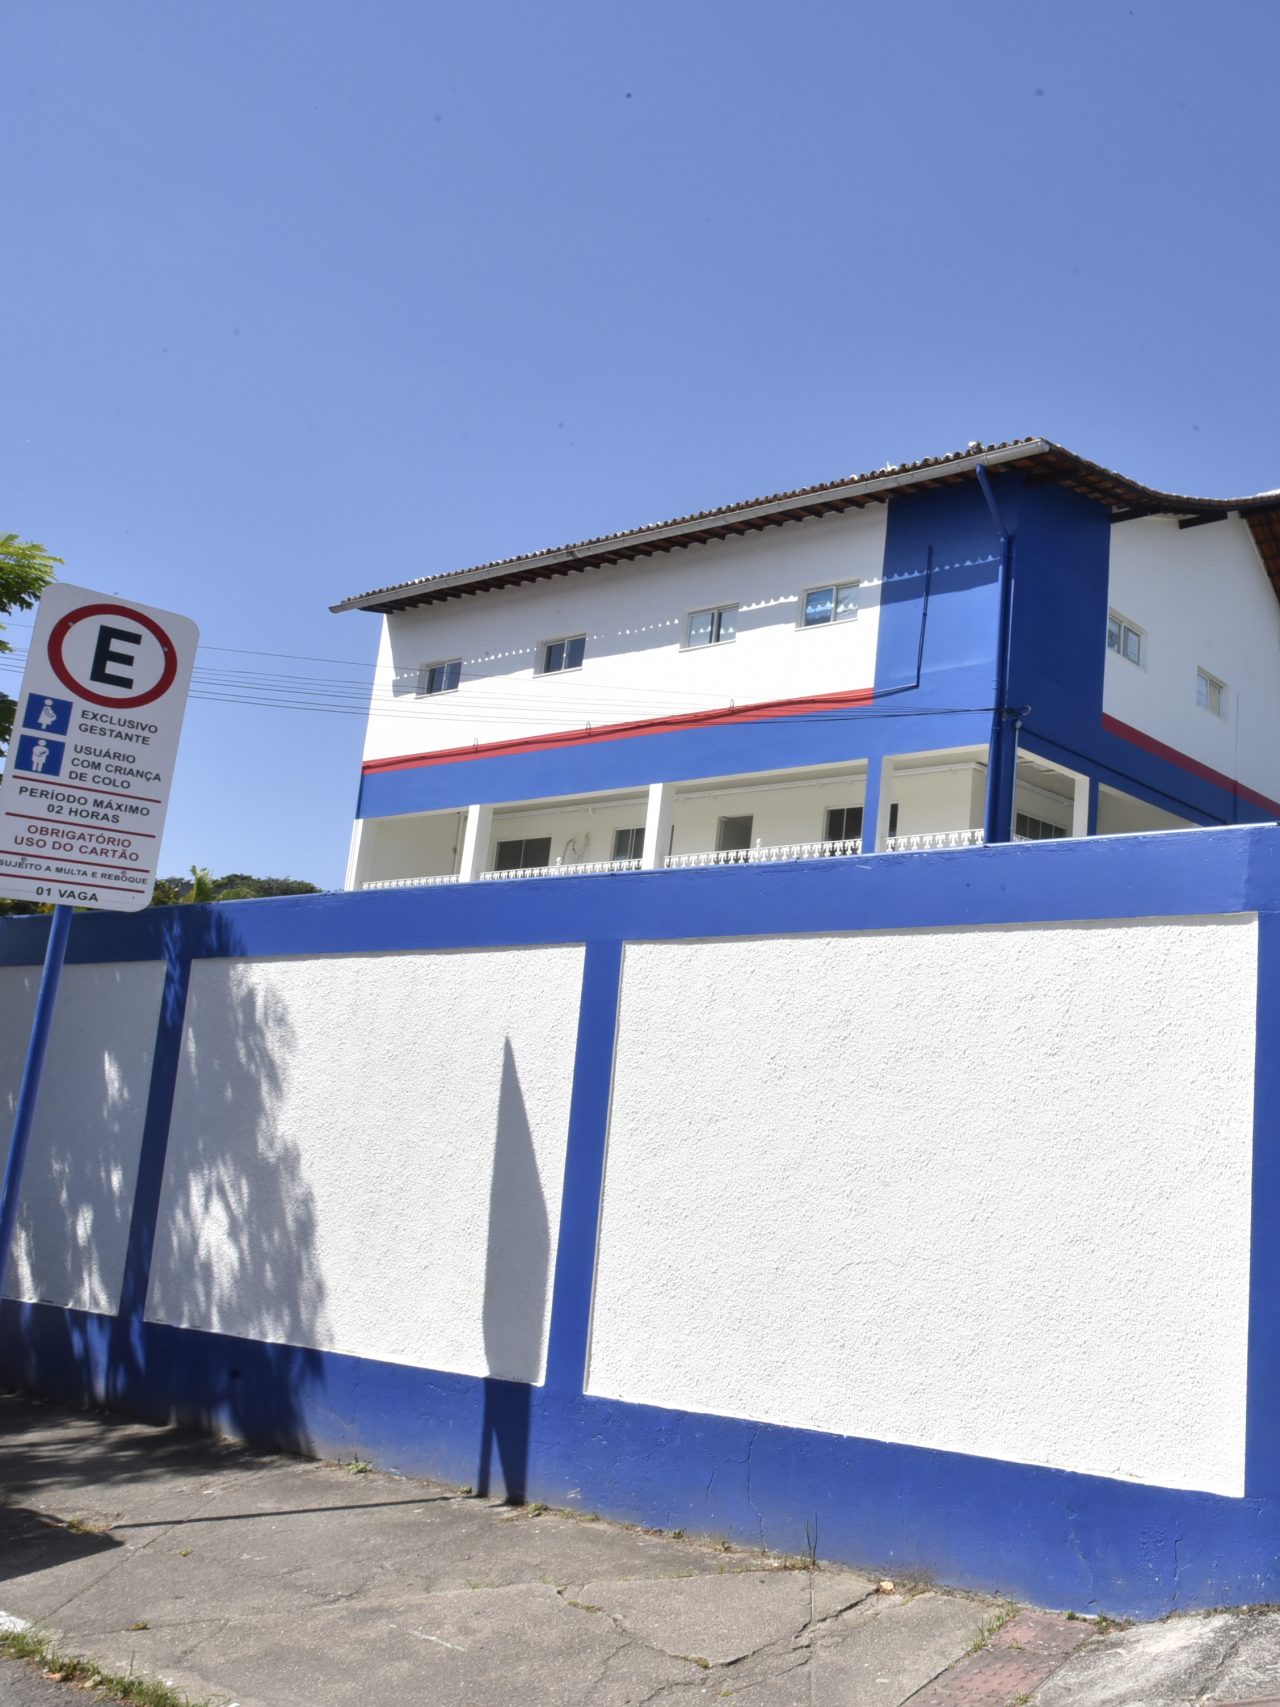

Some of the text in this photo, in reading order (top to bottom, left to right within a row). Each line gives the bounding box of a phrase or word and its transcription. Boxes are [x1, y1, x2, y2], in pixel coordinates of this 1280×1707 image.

[90, 624, 142, 690] E
[81, 709, 158, 734] EXCLUSIVO
[78, 723, 151, 746] GESTANTE
[73, 743, 136, 764] USUÁRIO
[68, 770, 131, 789] DE COLO
[71, 757, 162, 783] COM CRIANÇA
[18, 786, 150, 816] PERÍODO MÁXIMO
[47, 803, 120, 824] 02 HORAS
[27, 824, 132, 848] OBRIGATÓRIO
[14, 835, 139, 862] USO DO CARTÃO
[55, 866, 88, 877] MULTA
[100, 872, 148, 885] REBOQUE
[35, 886, 98, 902] 01 VAGA
